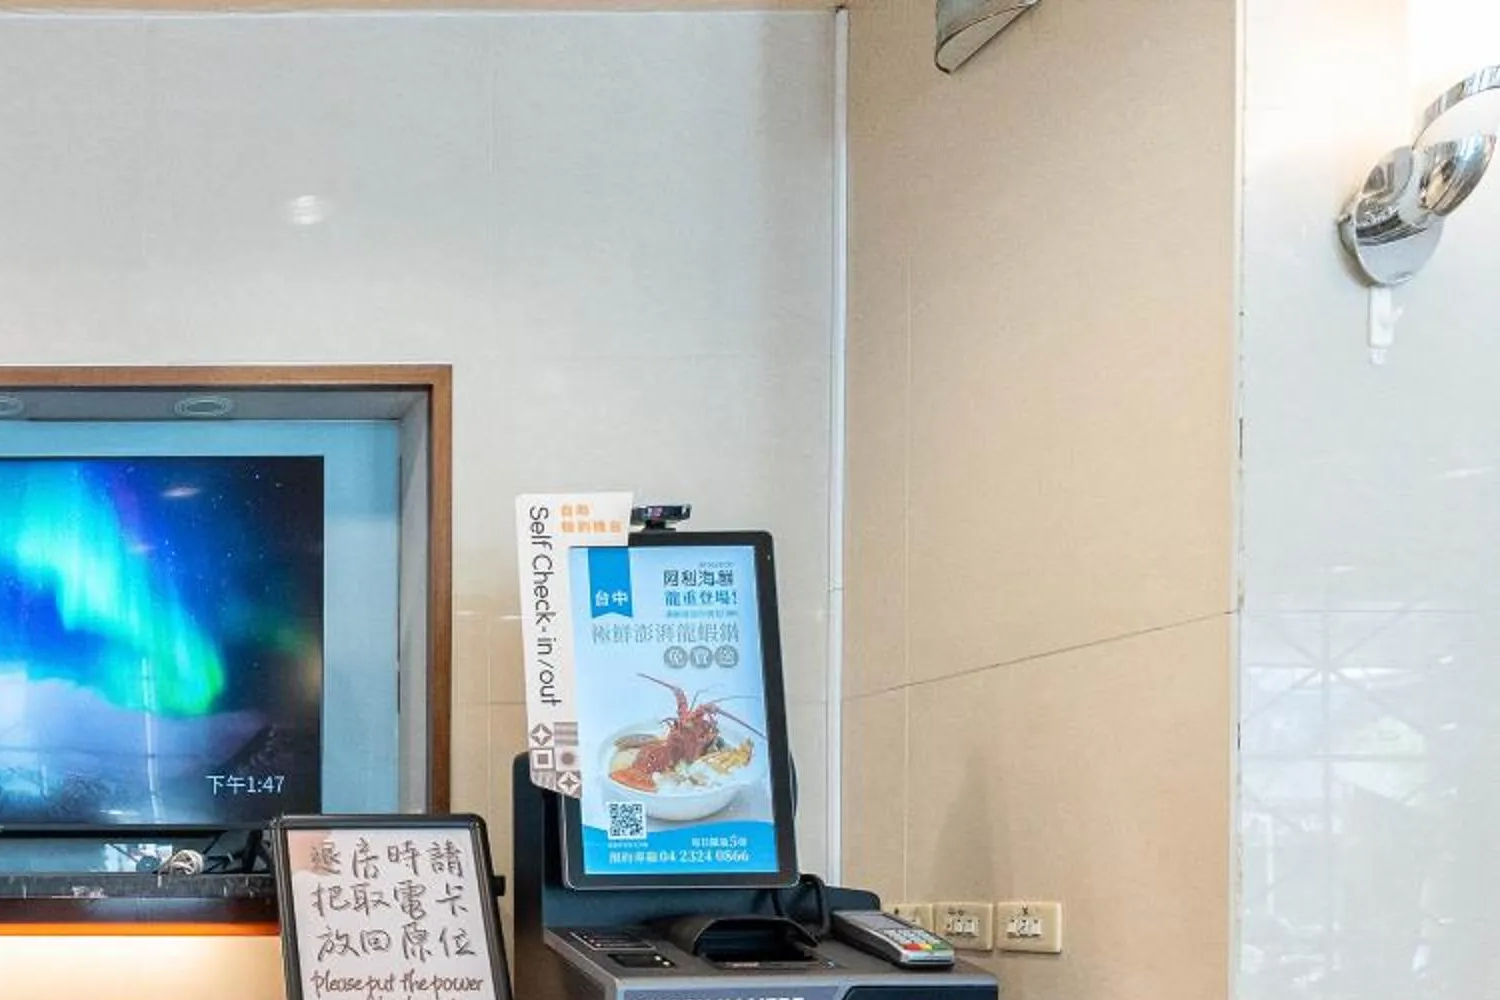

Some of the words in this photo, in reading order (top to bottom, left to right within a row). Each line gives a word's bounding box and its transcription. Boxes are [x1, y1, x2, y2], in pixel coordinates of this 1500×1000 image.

[530, 506, 553, 551] Self
[595, 590, 628, 608] 台中
[205, 775, 285, 796] 下午1:47
[310, 880, 469, 920] 把取電卡
[316, 921, 476, 963] 放回原位
[365, 975, 395, 1000] put
[400, 969, 428, 992] the
[430, 975, 484, 1000] power
